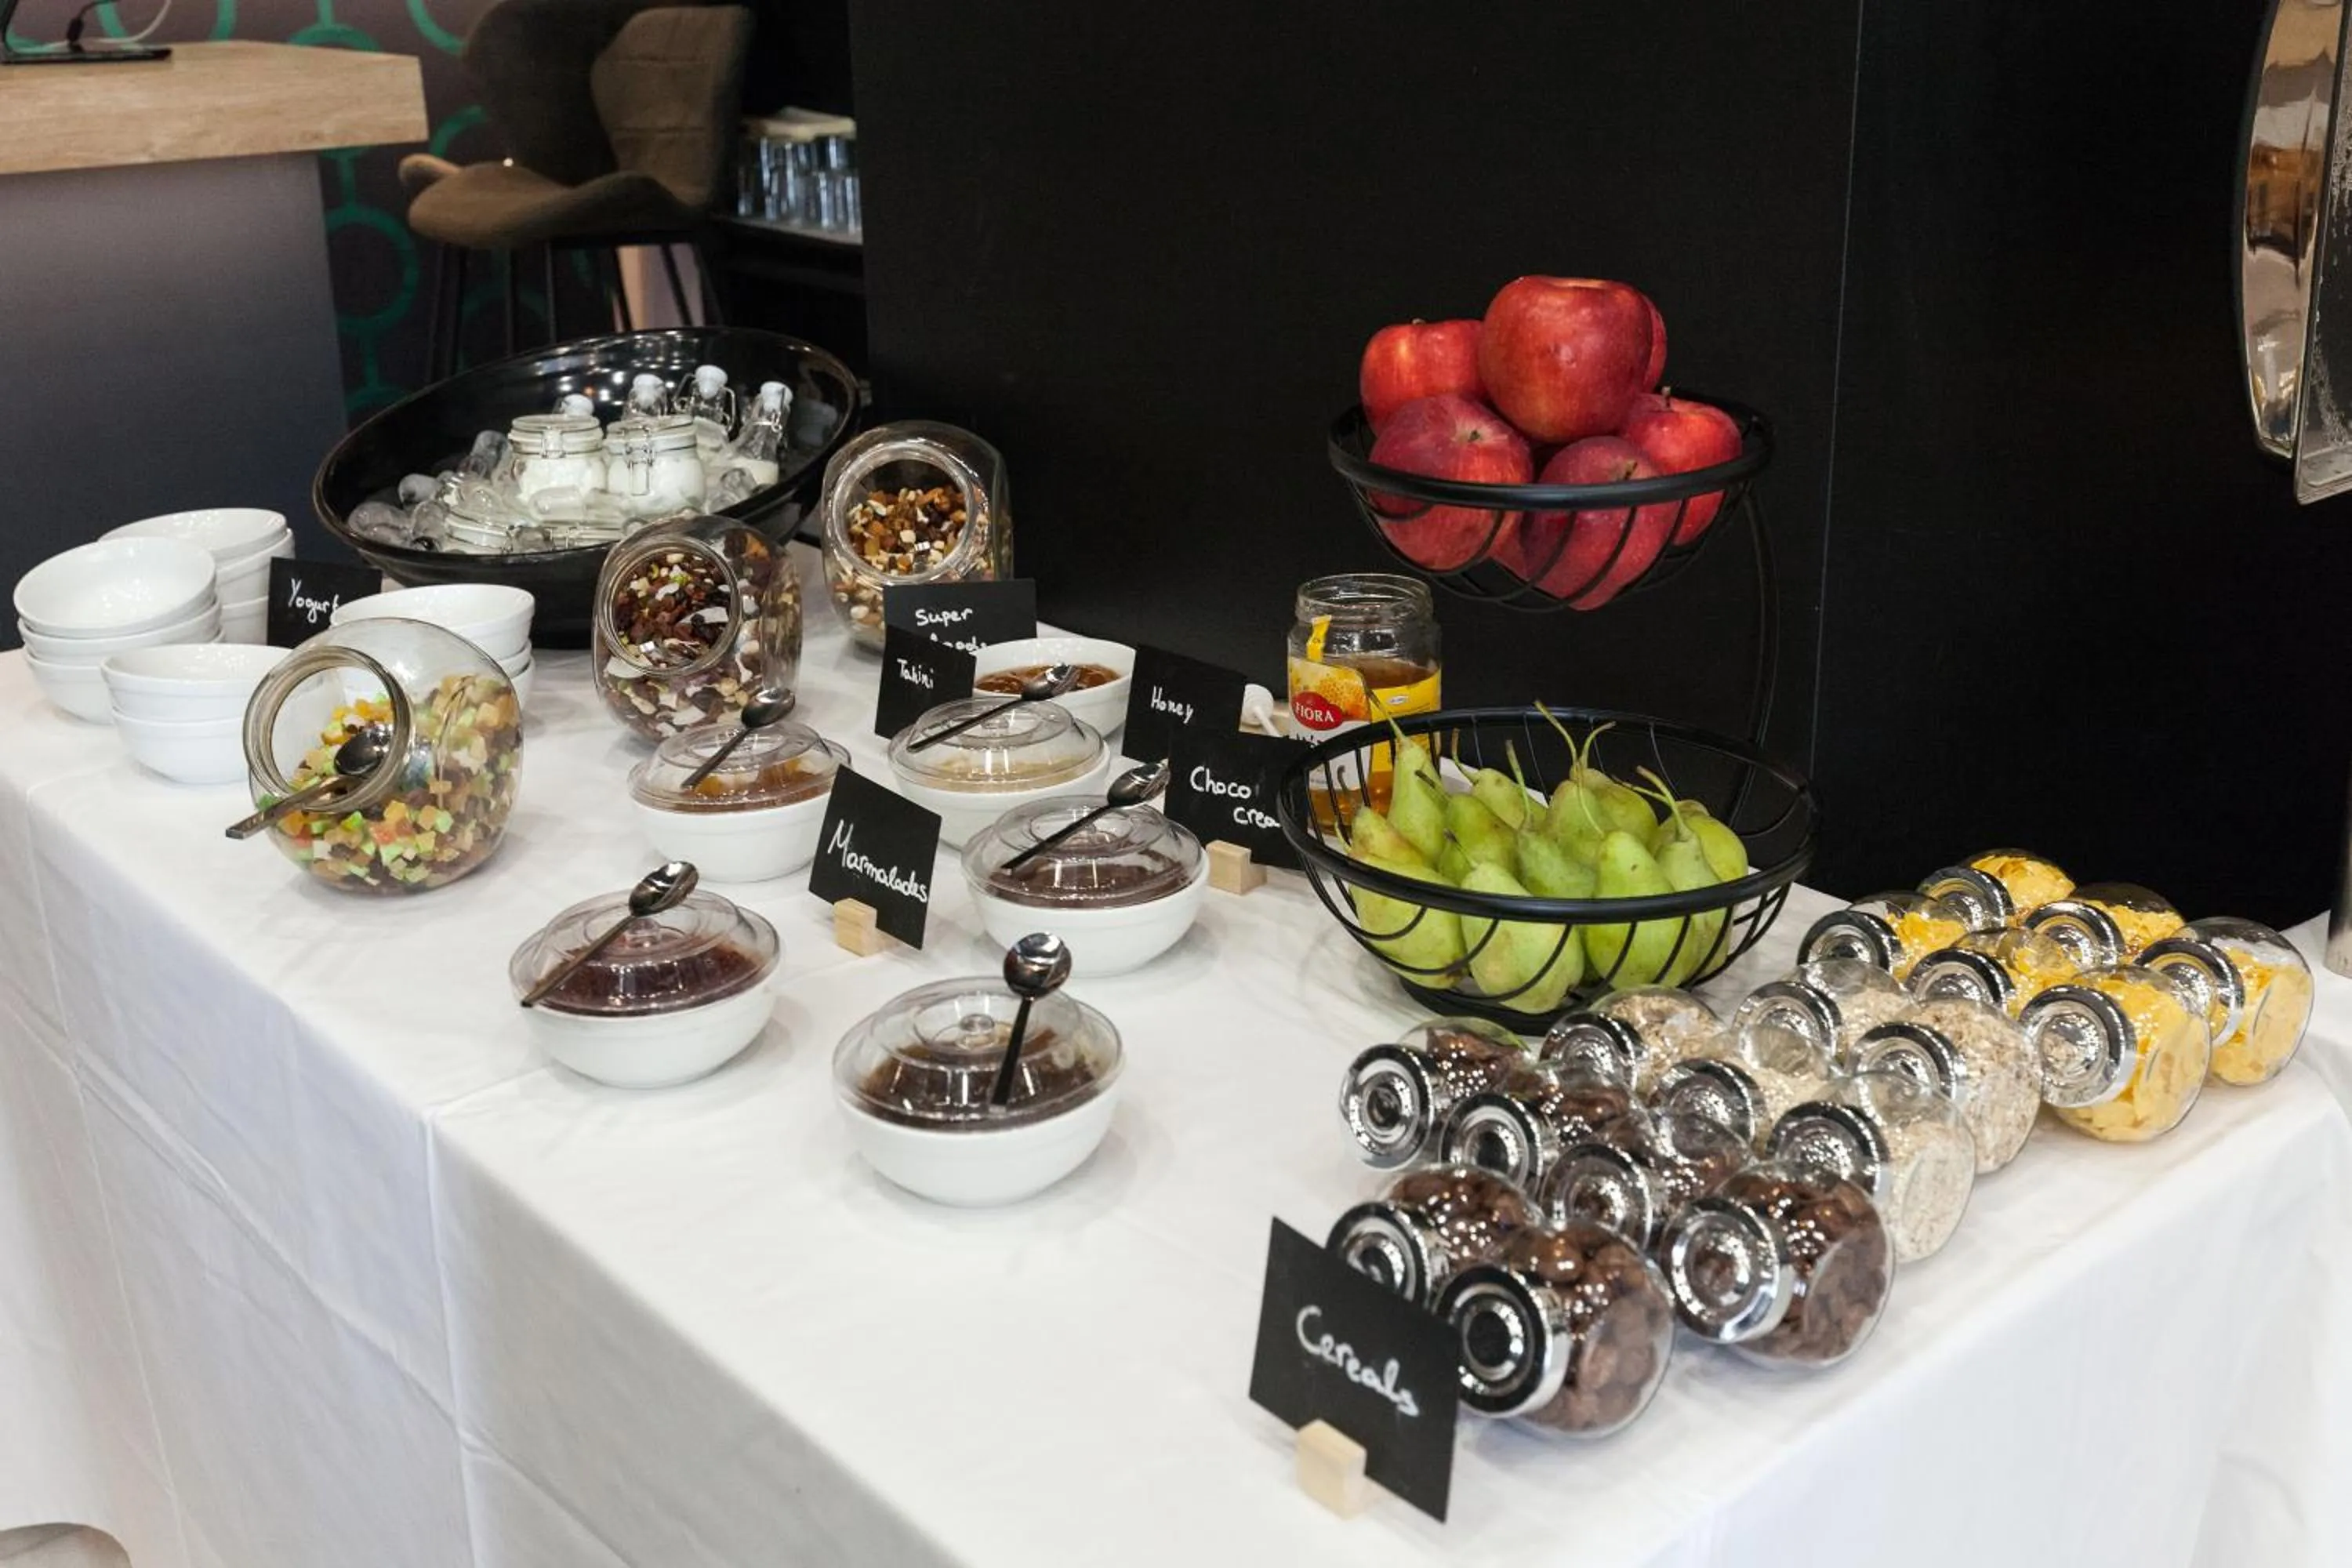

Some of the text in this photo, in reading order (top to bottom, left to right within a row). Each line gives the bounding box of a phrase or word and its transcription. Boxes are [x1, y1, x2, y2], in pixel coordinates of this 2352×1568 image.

[288, 578, 339, 623] Yogurt
[915, 607, 973, 626] Super
[897, 658, 934, 689] Tahini
[1151, 685, 1193, 724] Honey
[1190, 765, 1251, 799] Choco
[1233, 807, 1282, 828] Crea
[827, 819, 928, 903] Marmalades
[1296, 1305, 1420, 1417] Cereals
